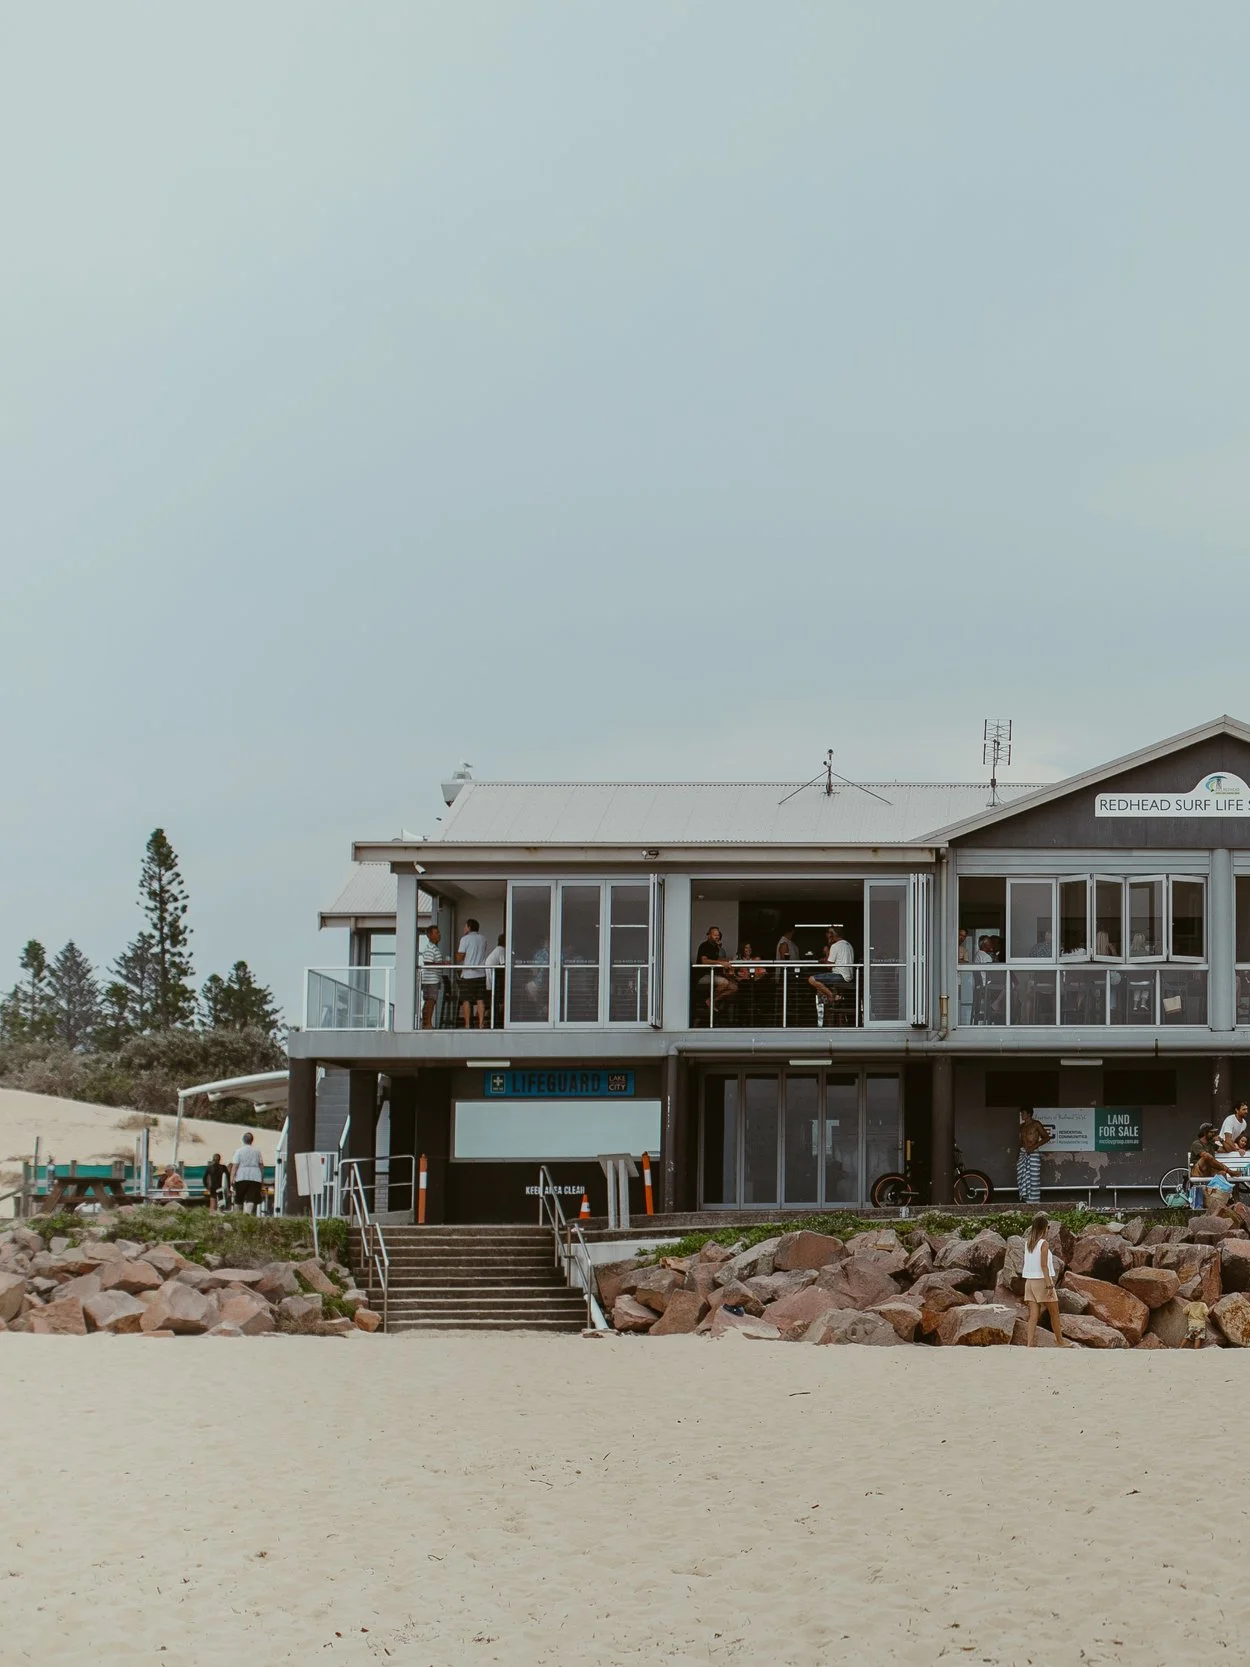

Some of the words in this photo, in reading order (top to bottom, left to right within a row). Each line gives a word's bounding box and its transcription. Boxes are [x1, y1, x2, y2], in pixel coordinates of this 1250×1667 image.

[1100, 799, 1171, 811] REDHEAD
[1175, 799, 1211, 811] SURF
[1216, 799, 1243, 811] LIFE
[512, 1073, 600, 1093] LIFEGUARD
[1107, 1114, 1130, 1125] LAND
[1099, 1126, 1116, 1137] FOR
[1118, 1126, 1139, 1137] SALE
